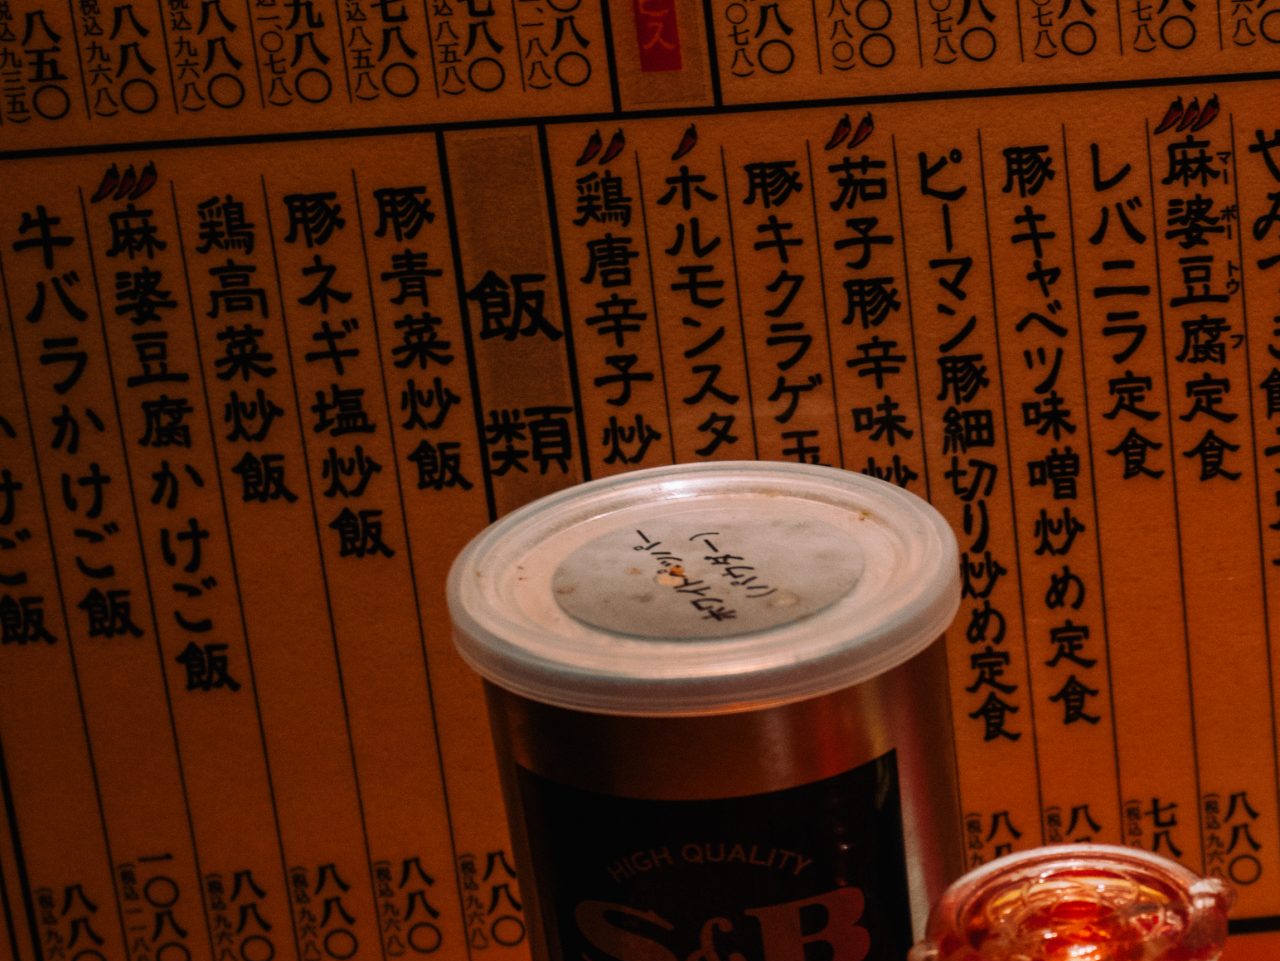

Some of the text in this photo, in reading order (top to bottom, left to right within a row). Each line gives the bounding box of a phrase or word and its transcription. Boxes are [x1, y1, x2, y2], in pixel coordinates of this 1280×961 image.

[109, 5, 158, 114] 八八〇
[198, 0, 245, 108] 八八〇
[13, 205, 143, 638] 牛バラかけご飯
[107, 204, 241, 691] 麻婆豆腐かけご飯
[196, 194, 298, 502] 鶏高菜炒飯
[284, 191, 394, 558] 豚ネギ塩炒飯
[373, 186, 474, 490] 豚青菜炒飯
[657, 166, 739, 456] ホルモンスタ
[917, 148, 1021, 742] ピーマン豚細切り炒め定食
[1088, 143, 1165, 481] レバニラ定食
[1162, 134, 1241, 483] 麻婆豆腐定食
[314, 863, 358, 960] 八八〇
[400, 857, 442, 954] 八八〇
[482, 850, 526, 947] 八八〇
[607, 843, 813, 882] HIGH QUALITY
[1223, 791, 1262, 886] 八八〇
